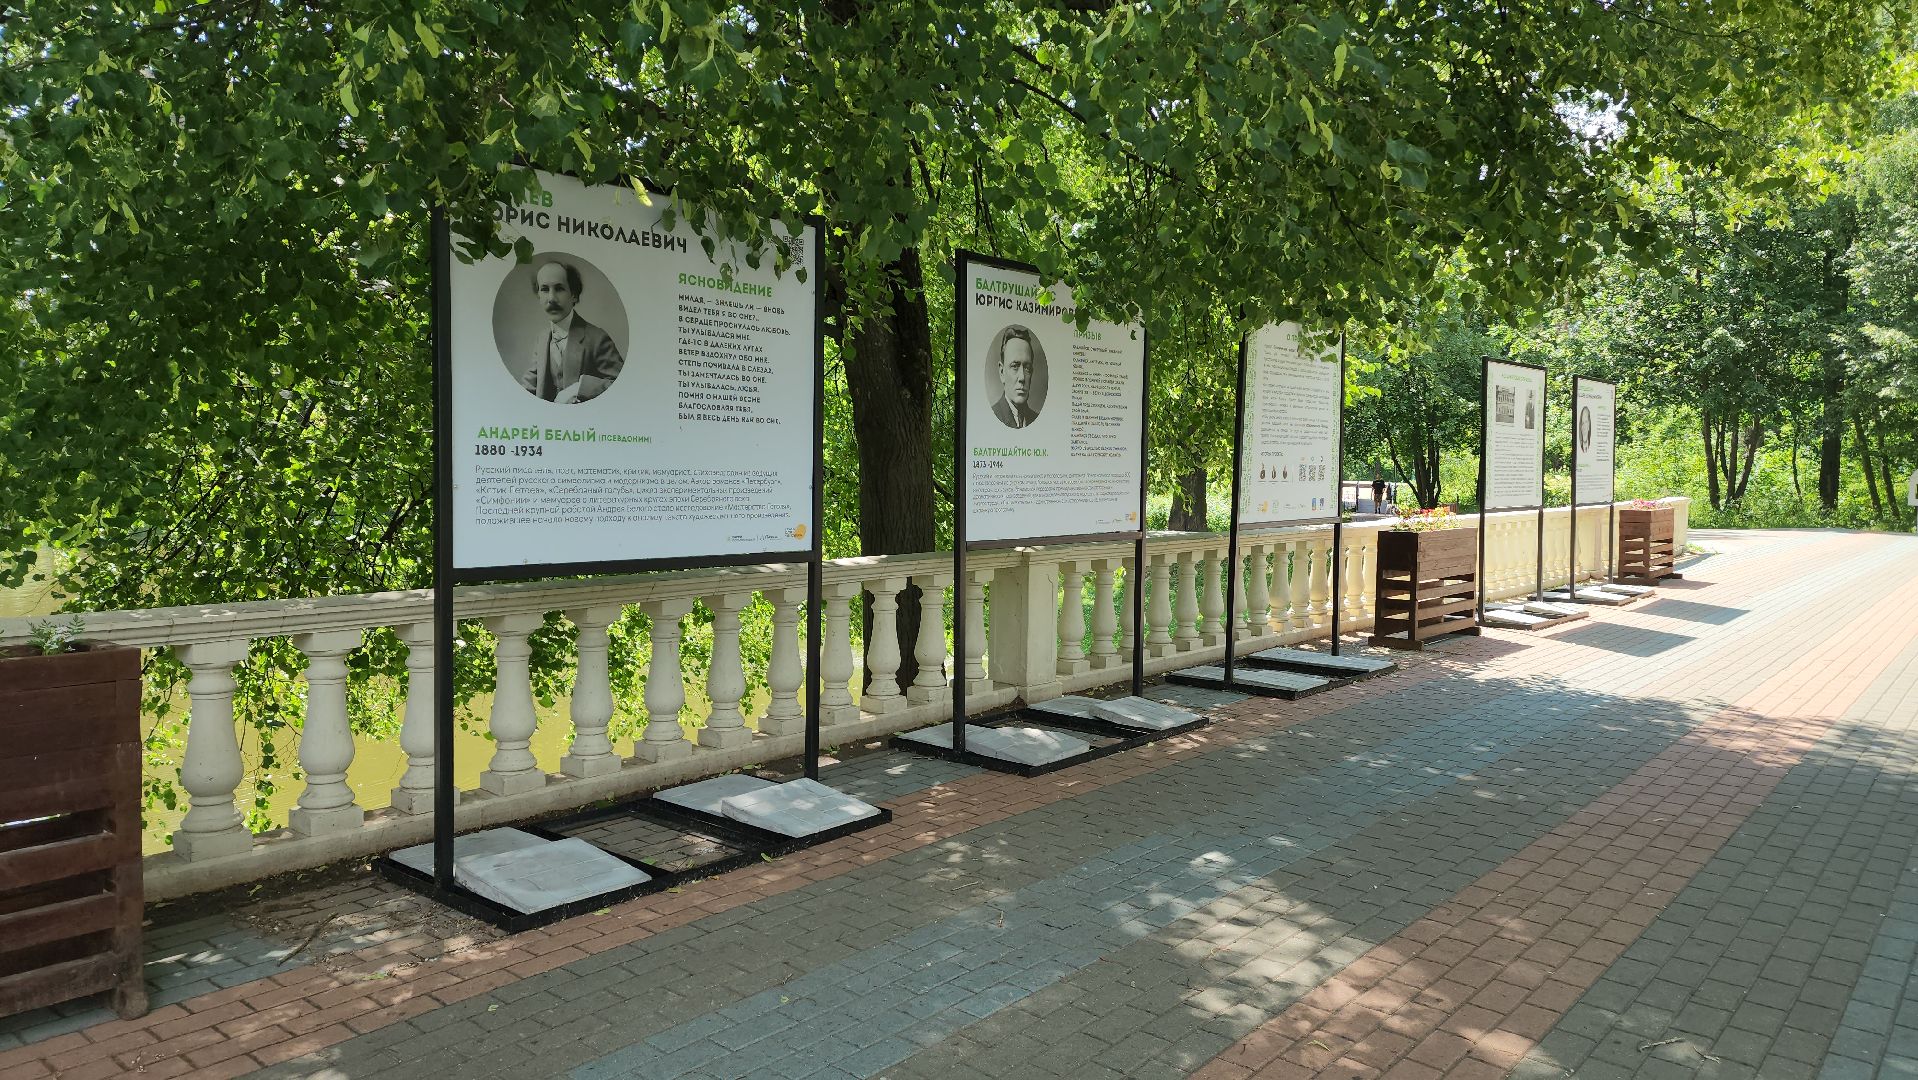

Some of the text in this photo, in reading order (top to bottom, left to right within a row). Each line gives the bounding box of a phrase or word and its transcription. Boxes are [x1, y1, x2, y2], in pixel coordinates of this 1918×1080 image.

[491, 202, 686, 253] ОРИС НИКОЛАЕВИЧ
[678, 273, 772, 298] ЯСНОВИДЕНИЕ
[975, 293, 1012, 310] ЮРГИС
[678, 304, 701, 314] ВИДЕЛ
[703, 307, 719, 316] ТЕБЯ
[727, 311, 737, 319] ВО
[763, 305, 784, 315] ВНОВЬ
[678, 315, 683, 323] В
[685, 316, 712, 326] СЕРДЦЕ
[713, 319, 759, 332] ПРОСНУЛАСЬ
[678, 326, 689, 334] ТЫ
[678, 337, 701, 346] ГДЕ-ТО
[678, 348, 699, 357] ВЕТЕР
[701, 350, 736, 360] ВЗДОХНУЛ
[738, 354, 752, 362] ОБО
[678, 358, 701, 368] СТЕПЬ
[702, 361, 739, 371] ПОЧИВАЛА
[741, 364, 745, 372] В
[678, 369, 689, 377] ТЫ
[690, 370, 739, 381] ЗАМЕЧТАЛАСЬ
[741, 374, 750, 382] ВО
[678, 380, 689, 388] ТЫ
[678, 390, 703, 400] ПОМНЯ
[705, 392, 711, 400] О
[712, 393, 739, 402] НАШЕЙ
[678, 402, 733, 412] БЛАГОСЛОВЛЯЯ
[678, 412, 694, 420] БЫЛ
[696, 413, 701, 421] Я
[702, 414, 720, 422] ВЕСЬ
[478, 425, 651, 443] АНДРЕЙ БЕЛЫЙ (ПСЕВДОНИМ)
[474, 443, 505, 456] 1880
[973, 446, 1048, 457] БАЛТРУШАЙТИС Ю.К.
